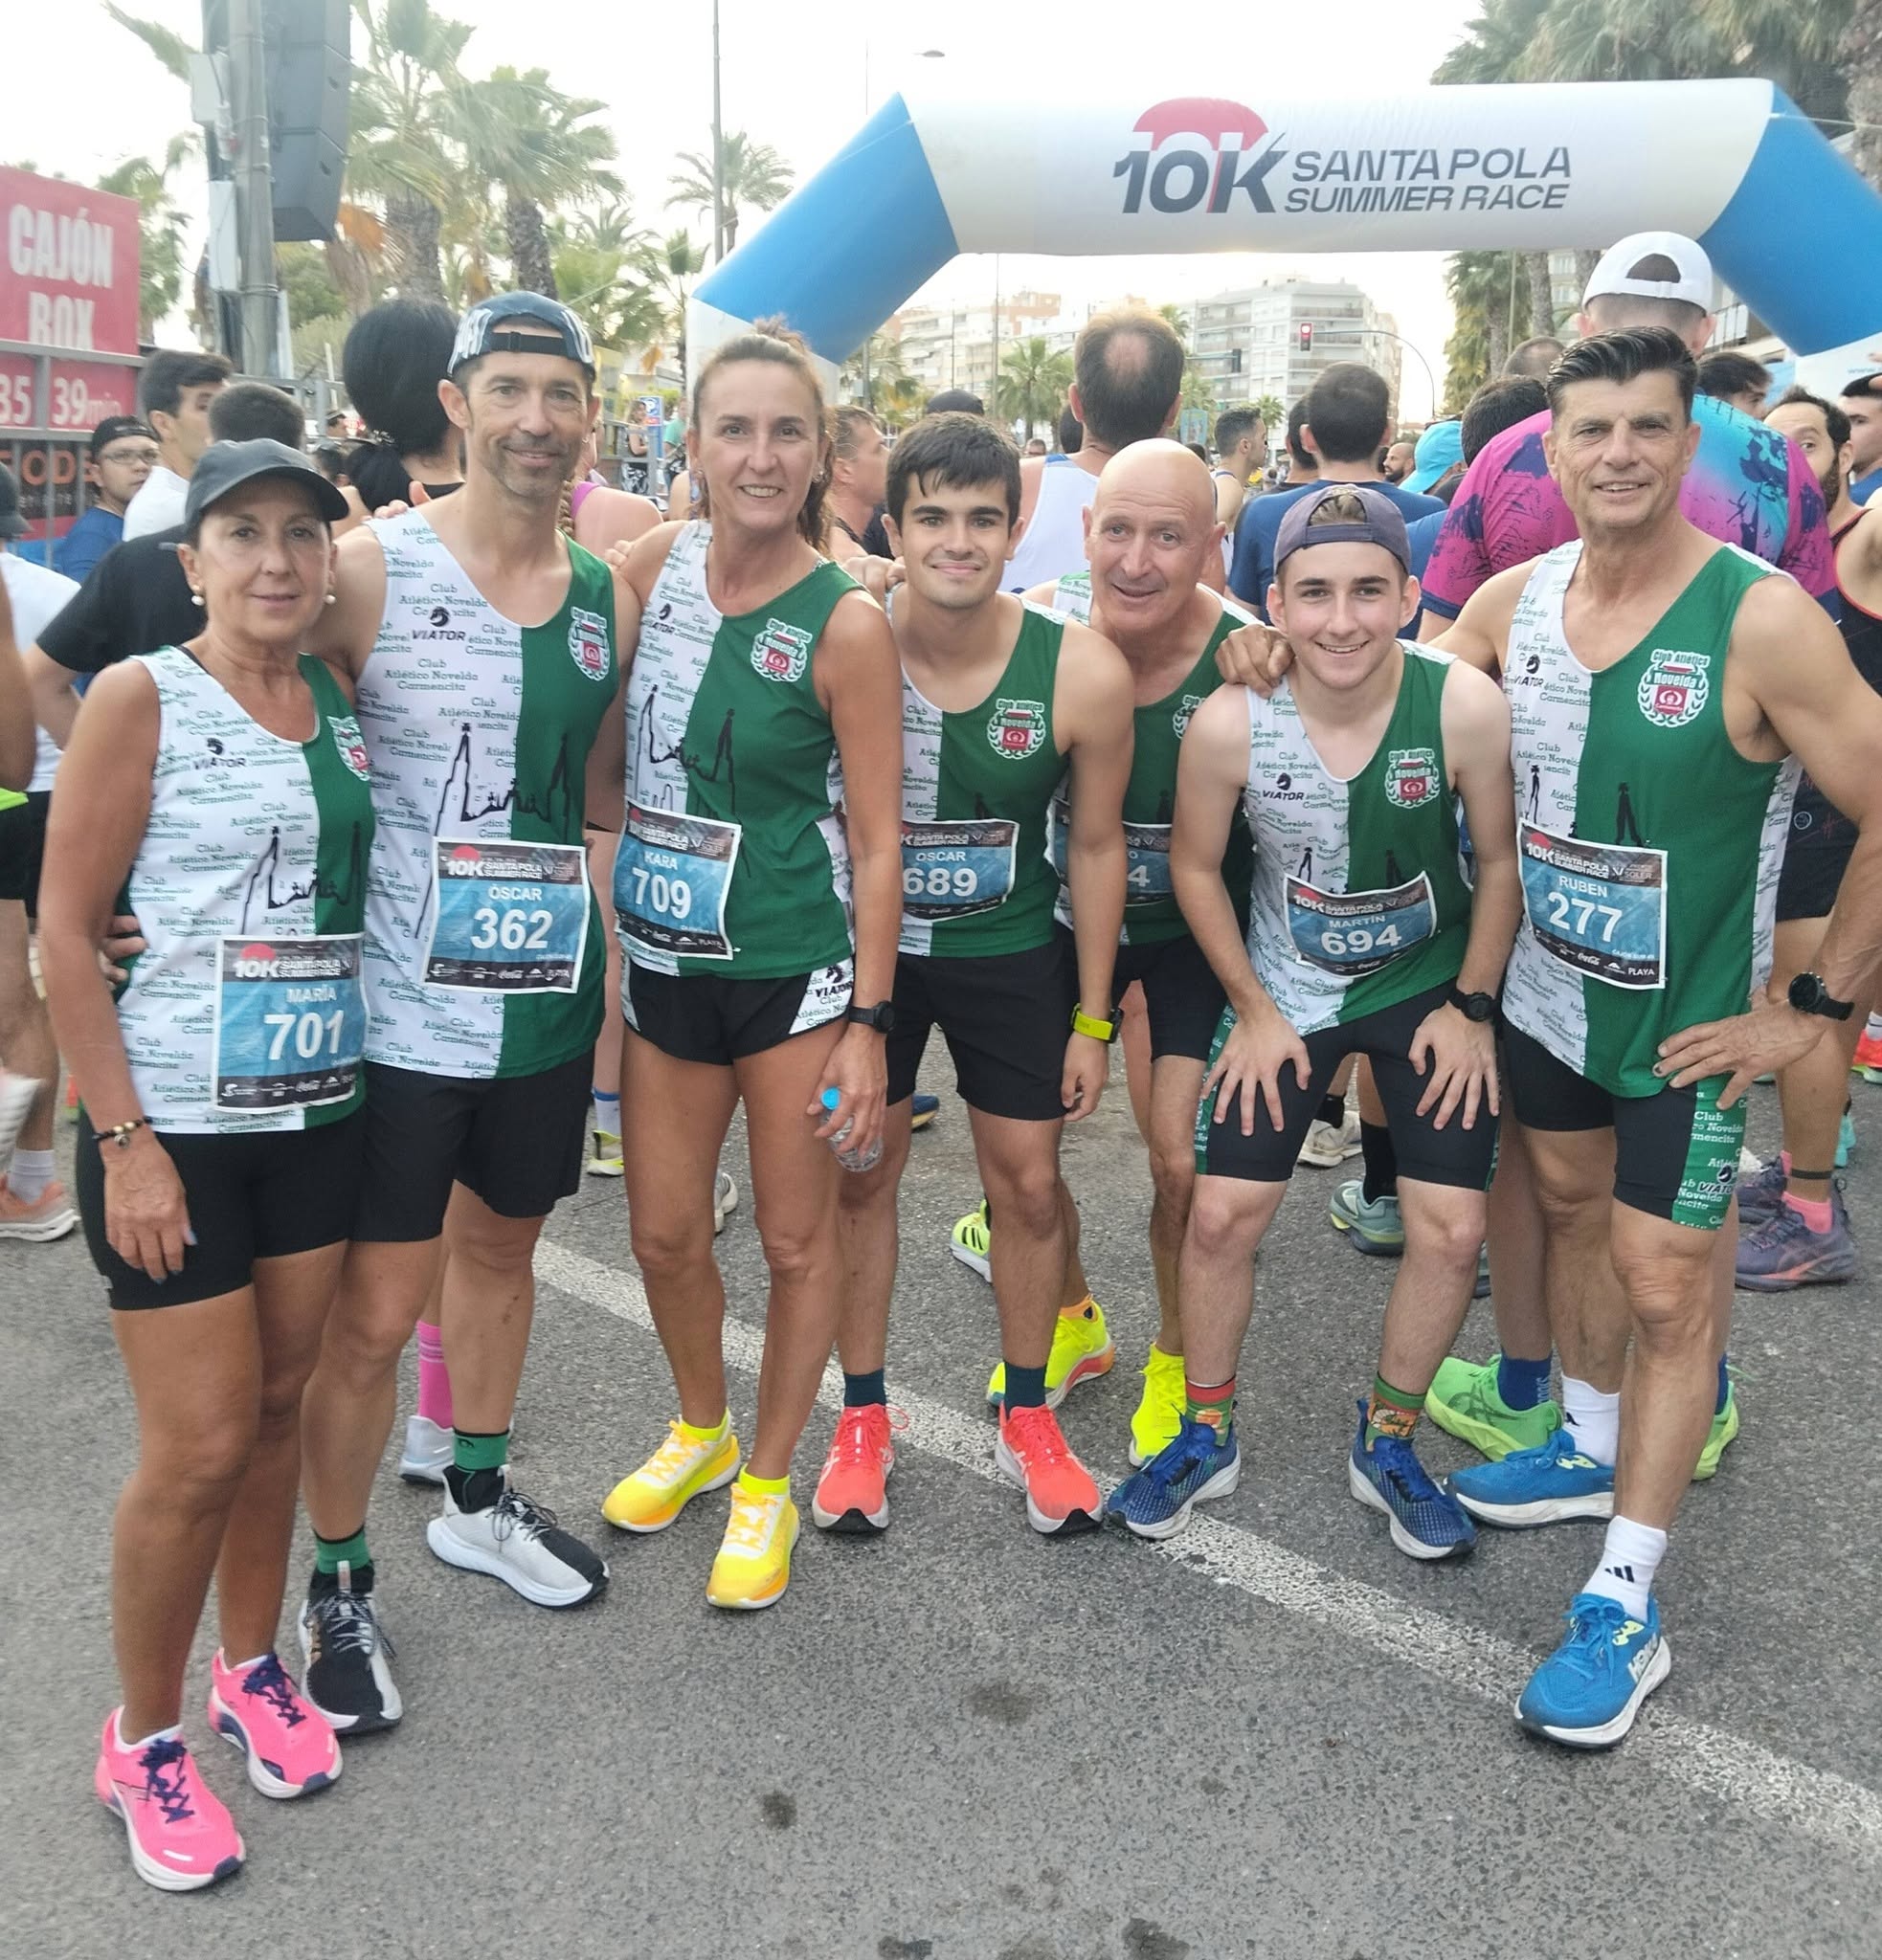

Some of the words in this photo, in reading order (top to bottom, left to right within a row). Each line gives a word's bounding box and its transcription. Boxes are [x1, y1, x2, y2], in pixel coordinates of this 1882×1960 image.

[1292, 148, 1440, 182] SANTA
[1448, 146, 1571, 181] POLA
[1112, 132, 1289, 213] 10K
[1284, 185, 1452, 212] SUMMER
[1460, 184, 1569, 211] RACE
[9, 204, 113, 287] CAJÓN
[29, 291, 94, 350] BOX
[430, 583, 458, 593] Club
[412, 630, 466, 641] VIATOR
[482, 624, 506, 635] Club
[417, 658, 446, 668] Club
[384, 670, 429, 680] Atlético
[432, 670, 479, 681] Novelda
[1557, 673, 1580, 684] Club
[1654, 672, 1696, 689] Novelda
[397, 680, 465, 691] Carmencita
[472, 698, 497, 707] Club
[438, 708, 481, 718] Atlético
[906, 705, 928, 715] Club
[1536, 743, 1561, 752] Club
[1263, 791, 1305, 801] VIATOR
[915, 851, 966, 861] OSCAR
[1526, 841, 1554, 863] 10K
[446, 860, 484, 877] 10K
[484, 862, 517, 872] SANTA
[518, 863, 542, 872] POLA
[1554, 853, 1583, 866] SANTA
[1583, 861, 1609, 872] POLA
[1554, 860, 1586, 875] SUMMER
[1586, 869, 1609, 879] RACE
[376, 866, 401, 878] Club
[904, 868, 977, 897] 689
[1558, 876, 1608, 898] RUBEN
[487, 884, 542, 901] ÓSCAR
[632, 867, 691, 919] 709
[1293, 895, 1325, 913] 10K
[1329, 915, 1385, 928] MARTÍN
[1546, 892, 1623, 943] 277
[469, 907, 553, 950] 362
[1321, 924, 1402, 955] 694
[233, 960, 280, 978] 10K
[280, 960, 314, 969] SANTA
[315, 959, 341, 969] POLA
[287, 984, 337, 1002] MARÍA
[820, 995, 842, 1004] Club
[263, 1010, 345, 1060] 701
[386, 1042, 413, 1053] Club
[1693, 1111, 1723, 1121] Club
[1707, 1123, 1744, 1133] Novelda
[1678, 1188, 1723, 1202] Novelda
